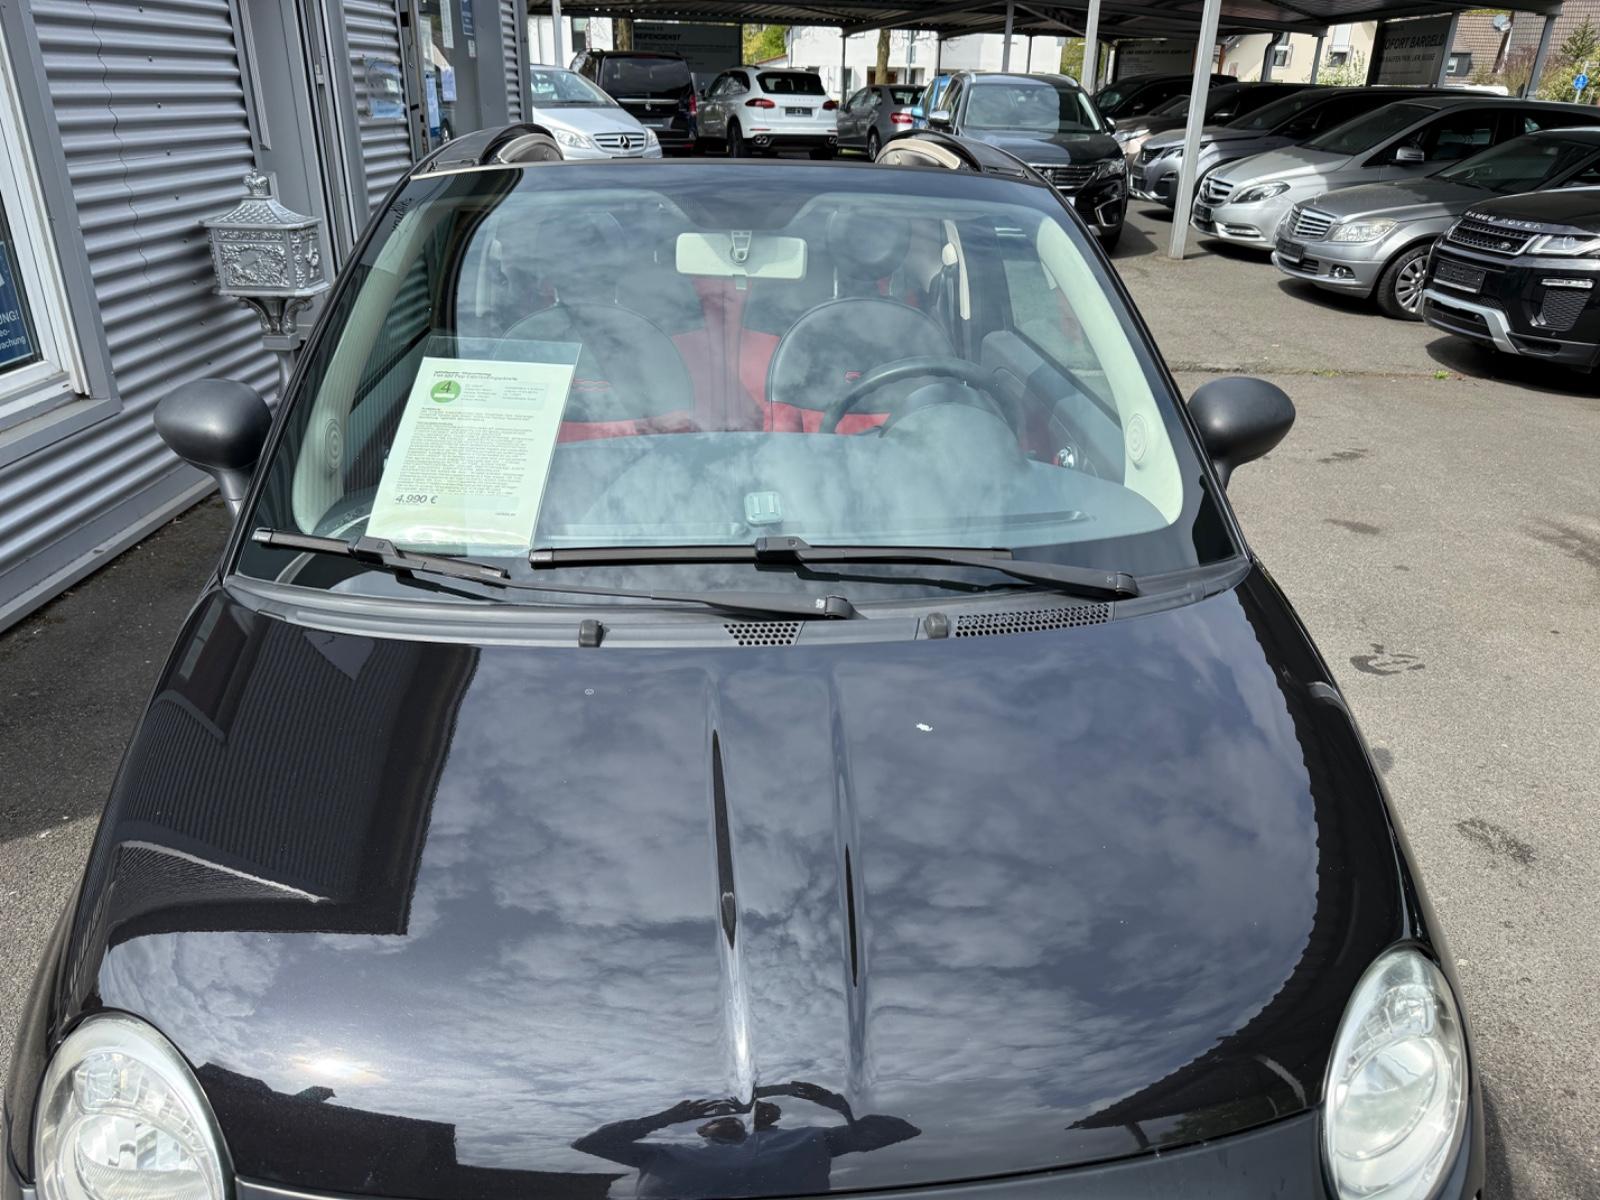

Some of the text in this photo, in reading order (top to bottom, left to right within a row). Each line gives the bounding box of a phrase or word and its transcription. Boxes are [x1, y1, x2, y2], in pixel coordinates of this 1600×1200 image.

[1384, 37, 1411, 50] OFORT
[1464, 211, 1544, 230] RANGE ROVER
[440, 380, 452, 393] 4
[395, 494, 438, 504] 4.990 €
